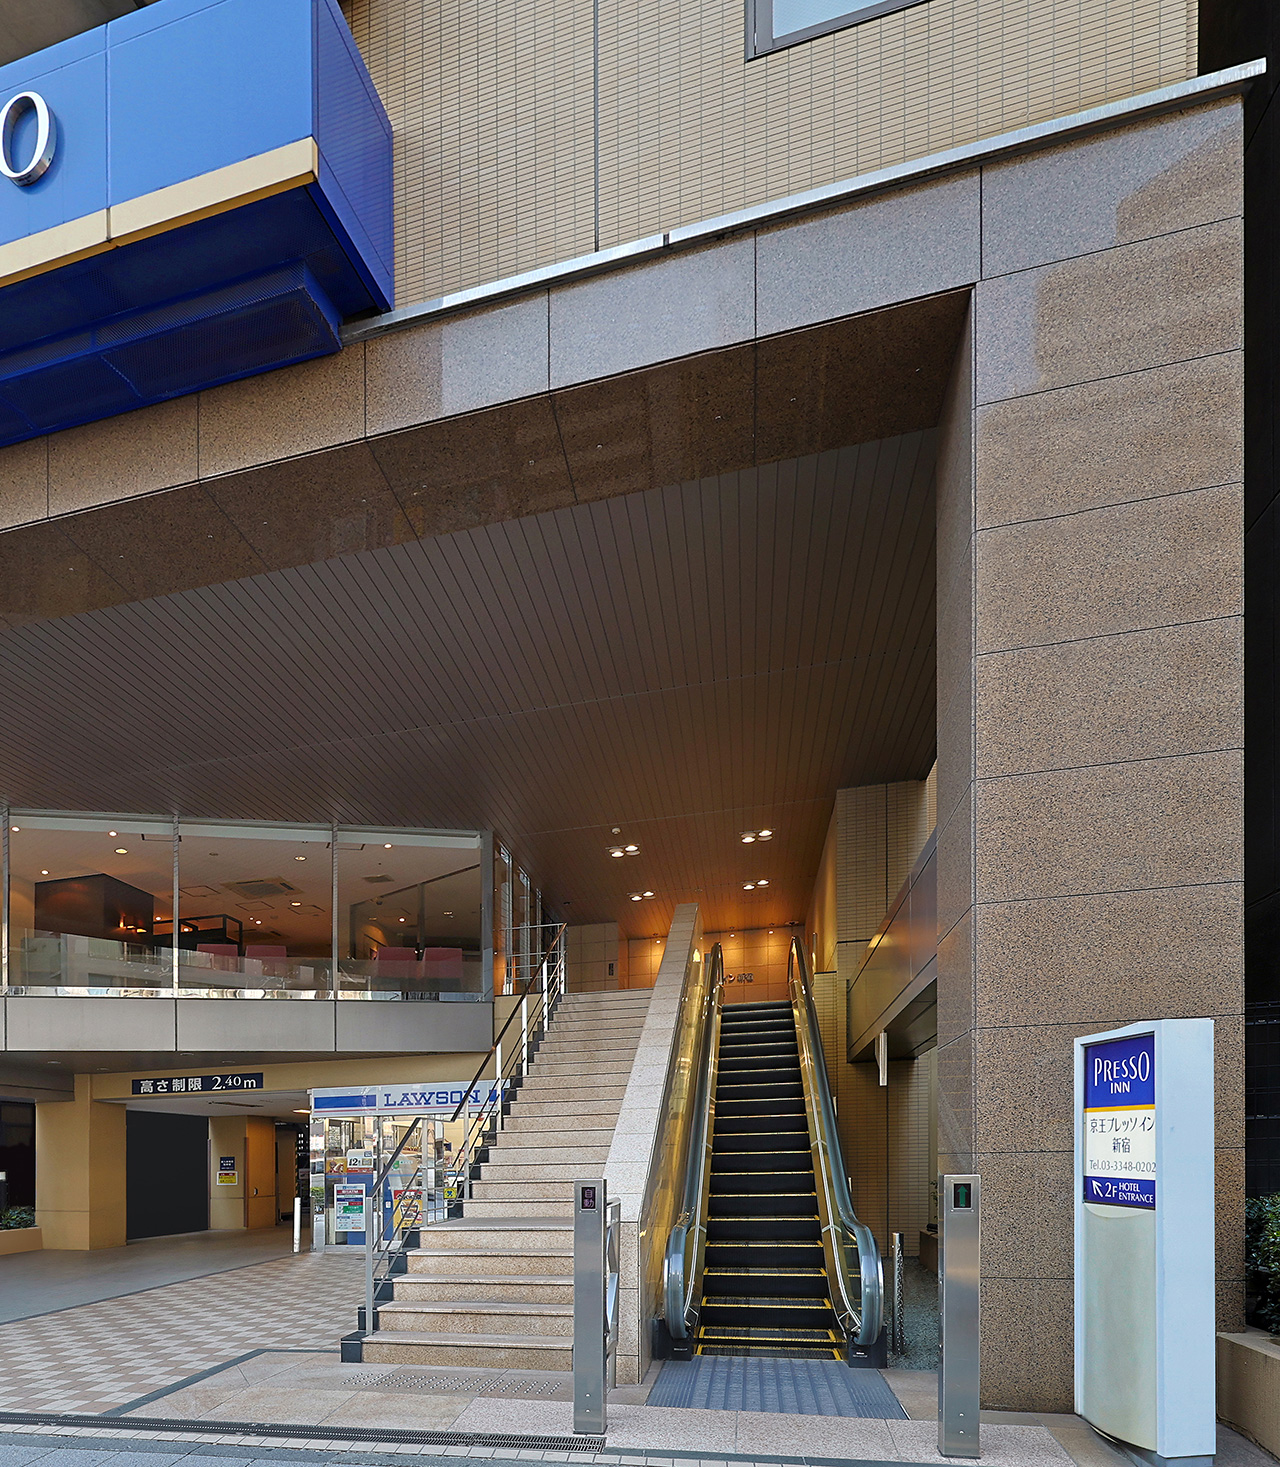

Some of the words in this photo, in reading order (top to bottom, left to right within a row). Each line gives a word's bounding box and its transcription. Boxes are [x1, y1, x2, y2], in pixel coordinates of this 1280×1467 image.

[1094, 1051, 1150, 1087] PRESSO
[140, 1078, 202, 1094] 高さ制限
[1110, 1081, 1130, 1094] INN
[384, 1089, 481, 1107] LAWSON
[1090, 1116, 1155, 1133] 京王プレッソイン
[1112, 1137, 1131, 1153] 新宿
[583, 1188, 595, 1208] 自動
[1105, 1182, 1117, 1198] 2F
[1118, 1182, 1140, 1192] HOTEL
[1118, 1192, 1154, 1204] ENTRANCE
